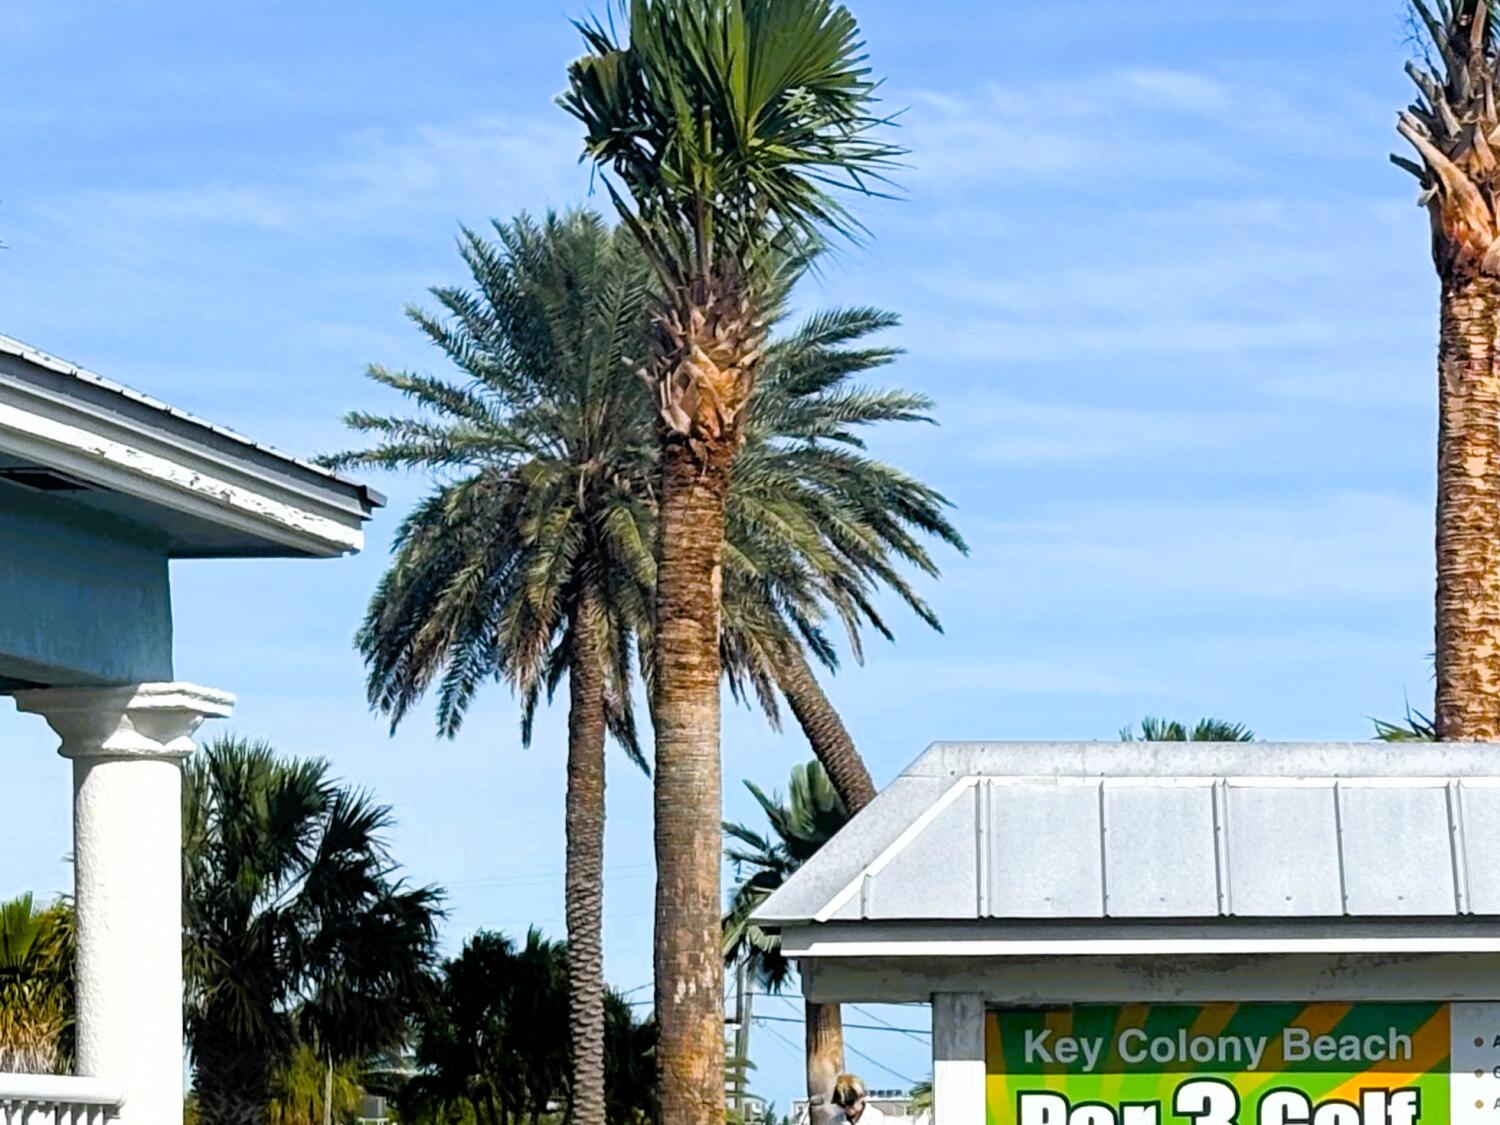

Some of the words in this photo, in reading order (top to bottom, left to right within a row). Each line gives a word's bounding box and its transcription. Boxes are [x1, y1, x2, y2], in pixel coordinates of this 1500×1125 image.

[1024, 1029, 1102, 1071] Key
[1118, 1028, 1266, 1070] Colony
[1283, 1027, 1412, 1061] Beach
